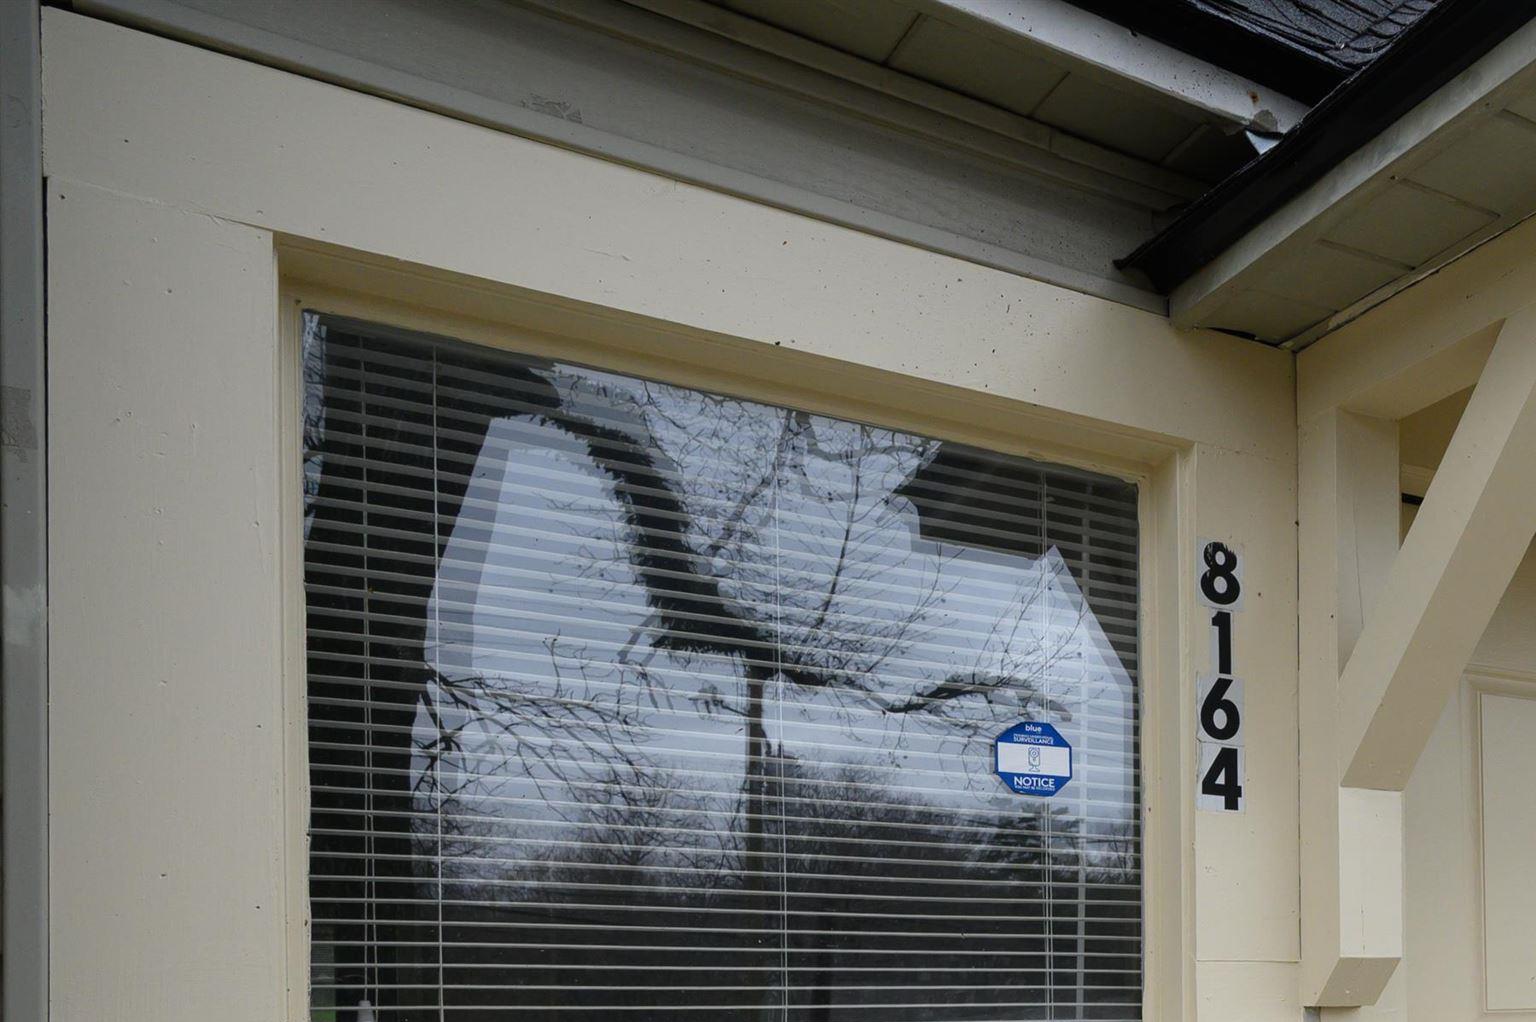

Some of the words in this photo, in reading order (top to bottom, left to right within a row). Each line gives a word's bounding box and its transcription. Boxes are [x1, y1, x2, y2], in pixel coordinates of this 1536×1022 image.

[1200, 541, 1243, 811] 8164
[1025, 724, 1042, 732] blue
[1014, 776, 1055, 788] NOTICE
